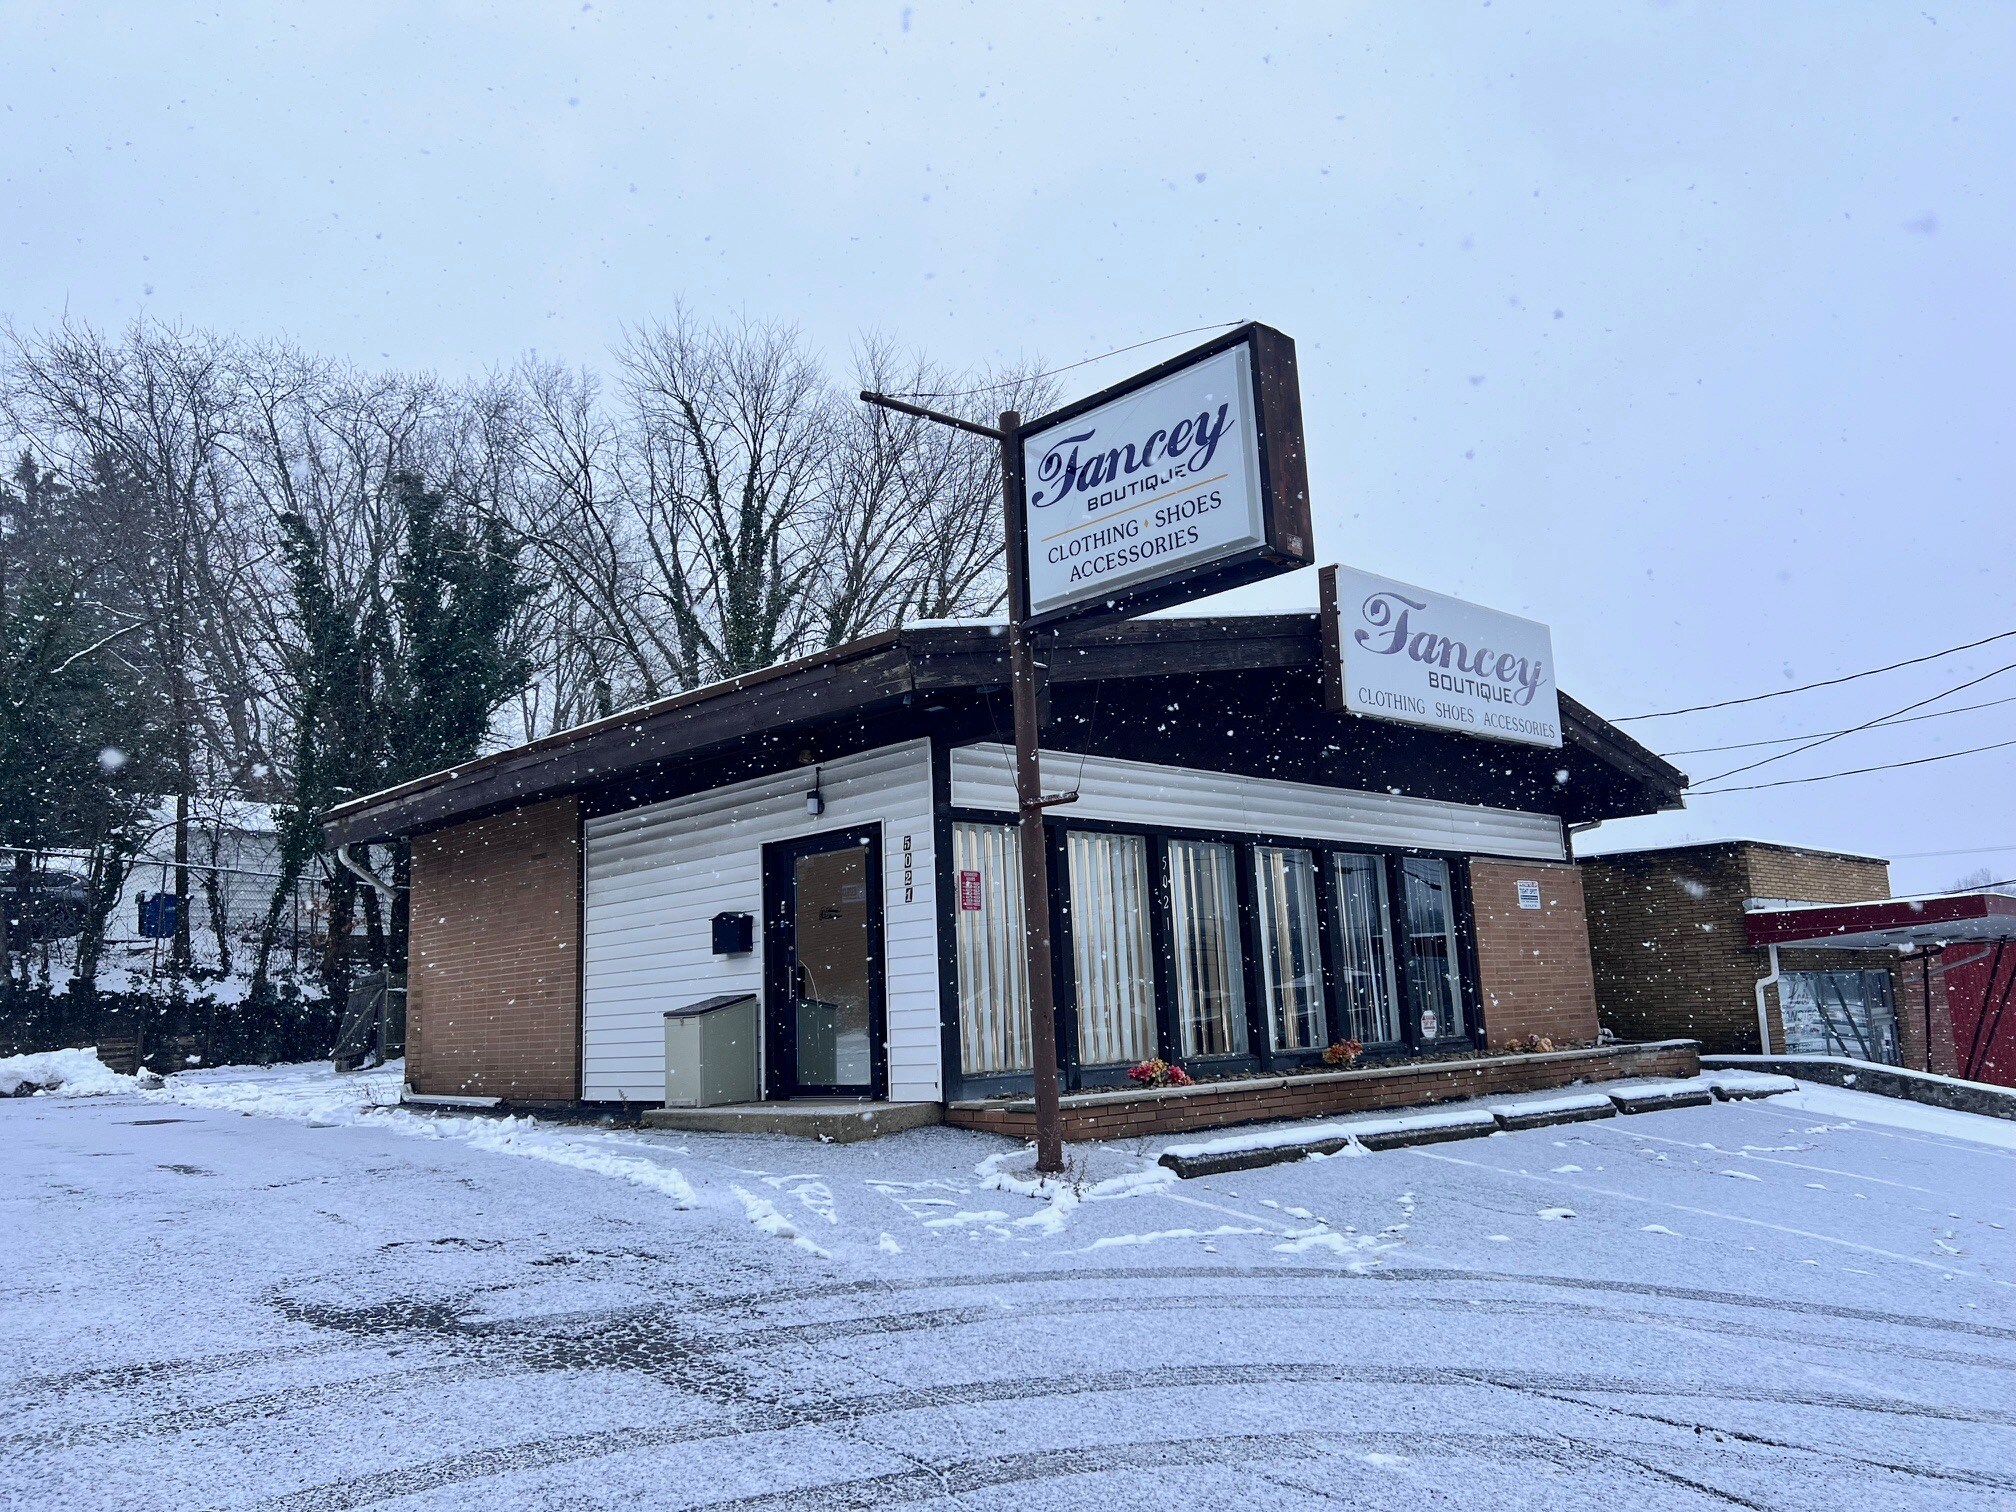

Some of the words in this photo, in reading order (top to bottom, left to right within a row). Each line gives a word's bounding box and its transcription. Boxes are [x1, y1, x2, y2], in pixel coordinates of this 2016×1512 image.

[1032, 402, 1235, 507] Fancey
[1087, 463, 1187, 512] BOUTIQUE
[1048, 520, 1139, 564] CLOTHING
[1155, 491, 1222, 527] SHOES
[1070, 526, 1199, 582] ACCESSORIES
[1354, 592, 1547, 706] Fancey
[1358, 687, 1426, 715] CLOTHING
[1435, 702, 1475, 724] SHOES
[1484, 712, 1555, 738] ACCESSORIES
[1428, 670, 1513, 705] BOUTIQUE
